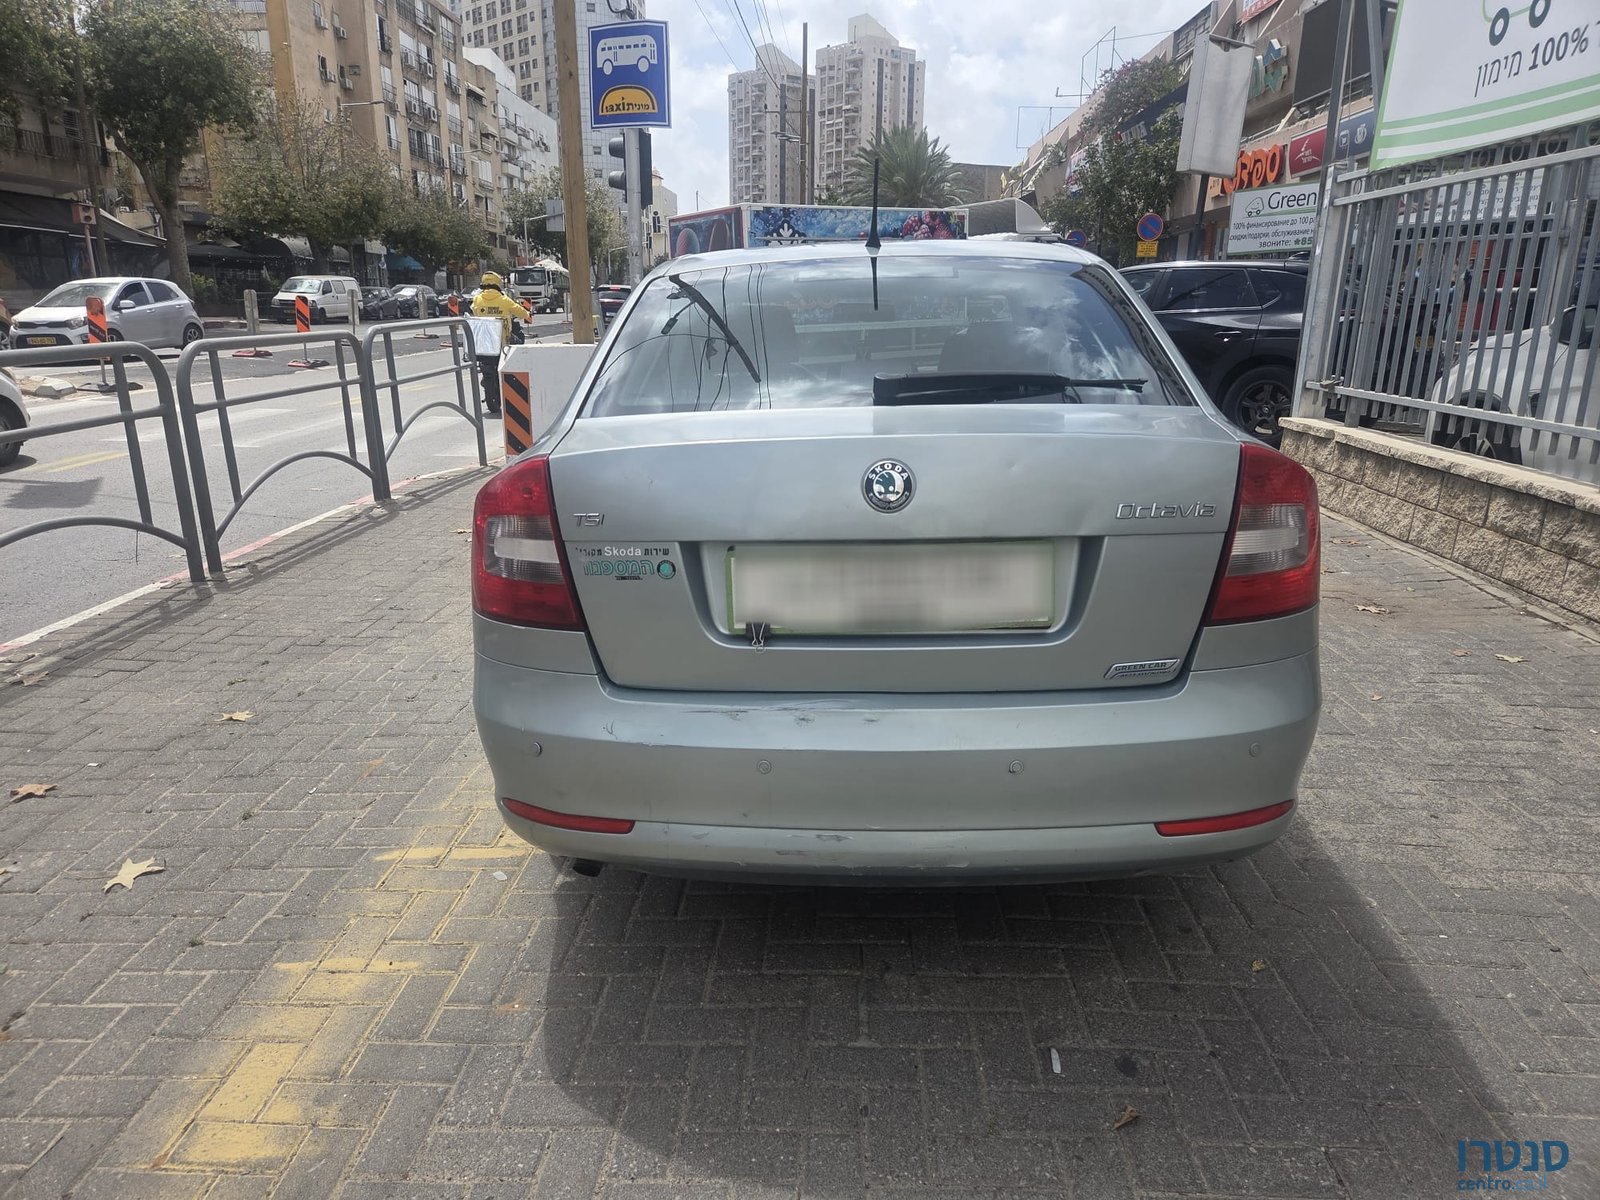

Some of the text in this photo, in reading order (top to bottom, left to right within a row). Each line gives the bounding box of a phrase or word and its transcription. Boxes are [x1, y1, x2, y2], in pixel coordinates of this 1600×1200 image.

[1528, 23, 1589, 71] 100%
[1474, 50, 1522, 98] מימון
[605, 96, 626, 113] taxi
[626, 102, 650, 111] מונית
[1268, 191, 1317, 210] Green
[1290, 218, 1298, 226] до
[1299, 216, 1309, 225] 100
[1259, 239, 1292, 249] звоните:
[868, 463, 909, 481] SKODA
[1115, 500, 1217, 520] Octavia
[604, 545, 642, 557] Skoda
[644, 547, 670, 556] שירות
[1114, 663, 1147, 672] GREEN
